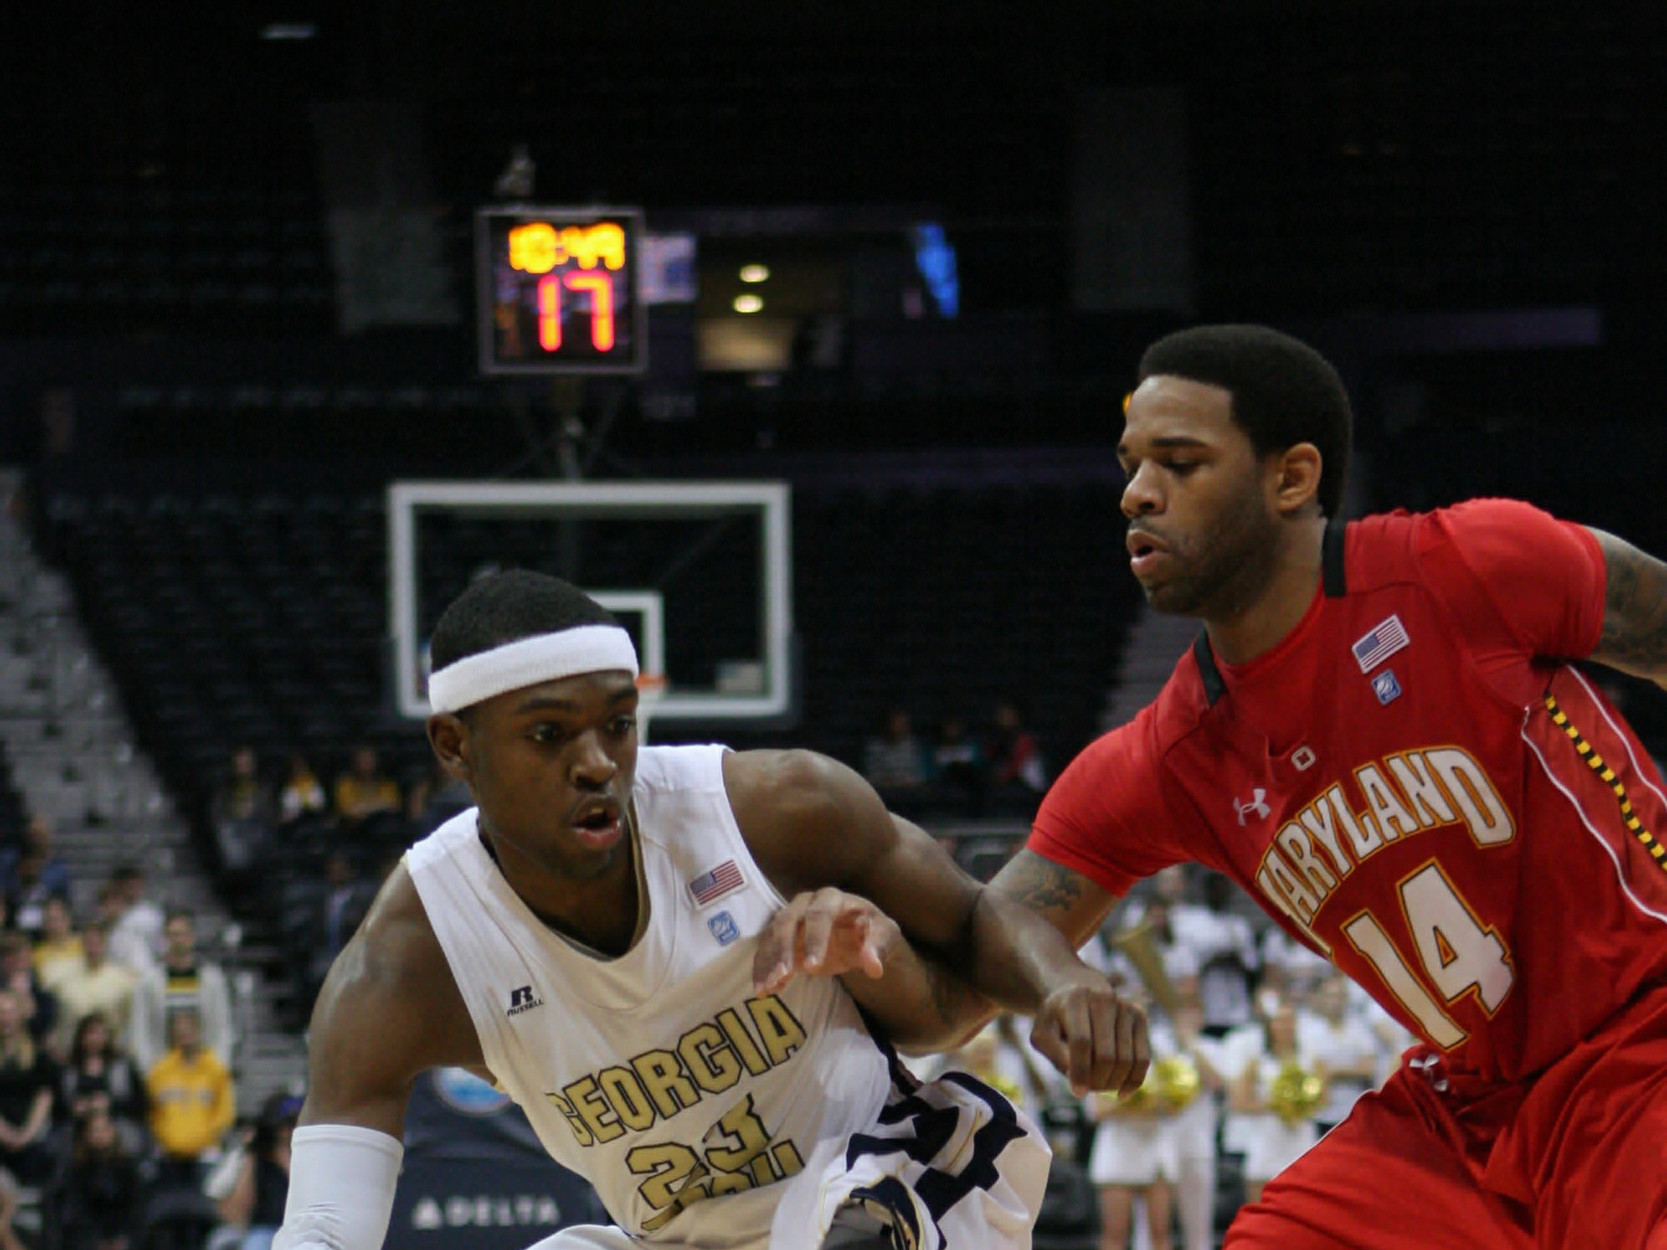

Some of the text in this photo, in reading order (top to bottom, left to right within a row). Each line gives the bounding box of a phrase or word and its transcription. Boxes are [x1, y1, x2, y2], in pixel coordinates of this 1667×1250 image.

[537, 270, 614, 352] 17
[1340, 857, 1515, 1053] 14
[544, 993, 807, 1147] GEORGIA
[445, 1196, 561, 1227] DELTA
